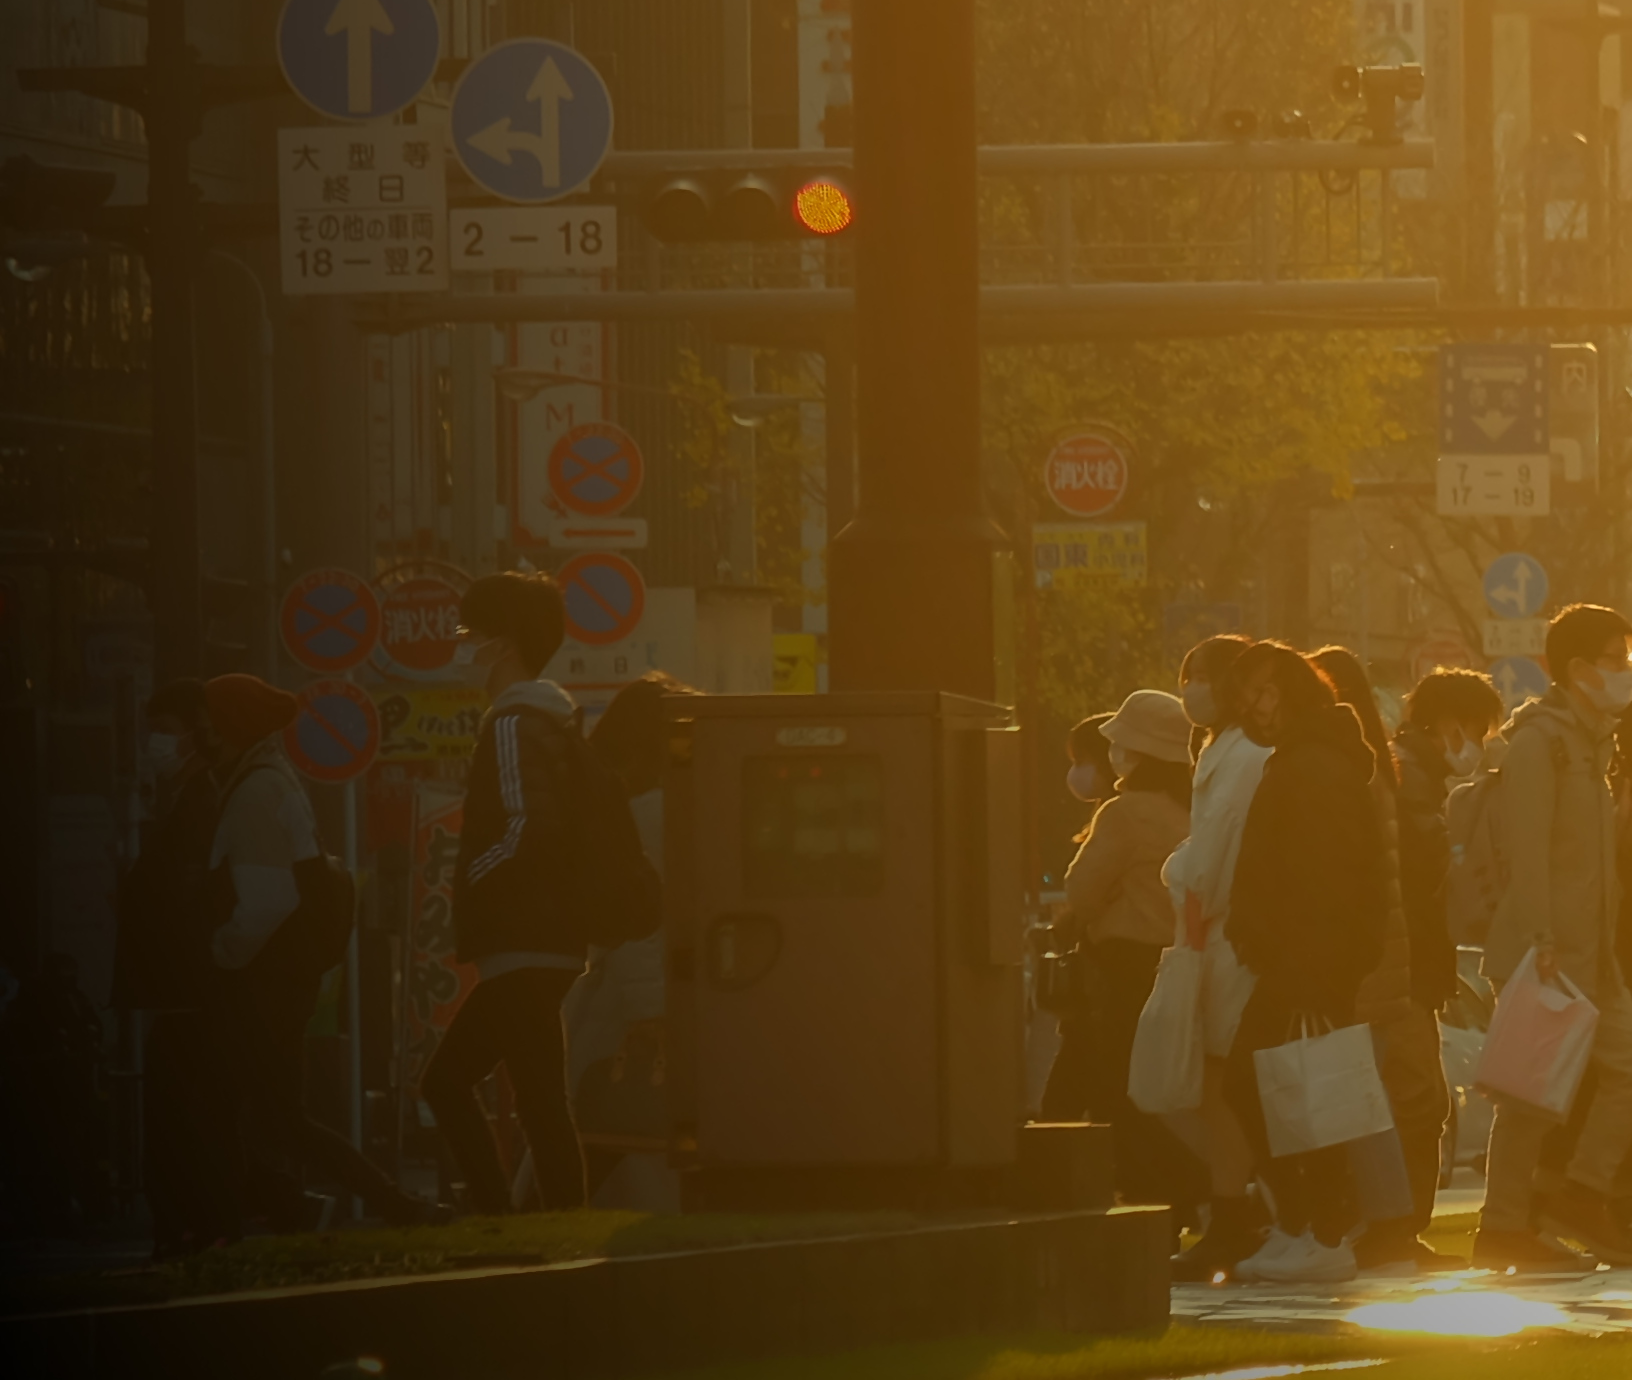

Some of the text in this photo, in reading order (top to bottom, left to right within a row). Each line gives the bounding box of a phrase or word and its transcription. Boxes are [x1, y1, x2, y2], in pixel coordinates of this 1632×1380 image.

[291, 141, 431, 171] 大型等
[322, 175, 405, 204] 終日
[292, 212, 434, 243] その他の車両
[1053, 459, 1120, 491] 消火栓
[384, 602, 461, 645] 消火栓
